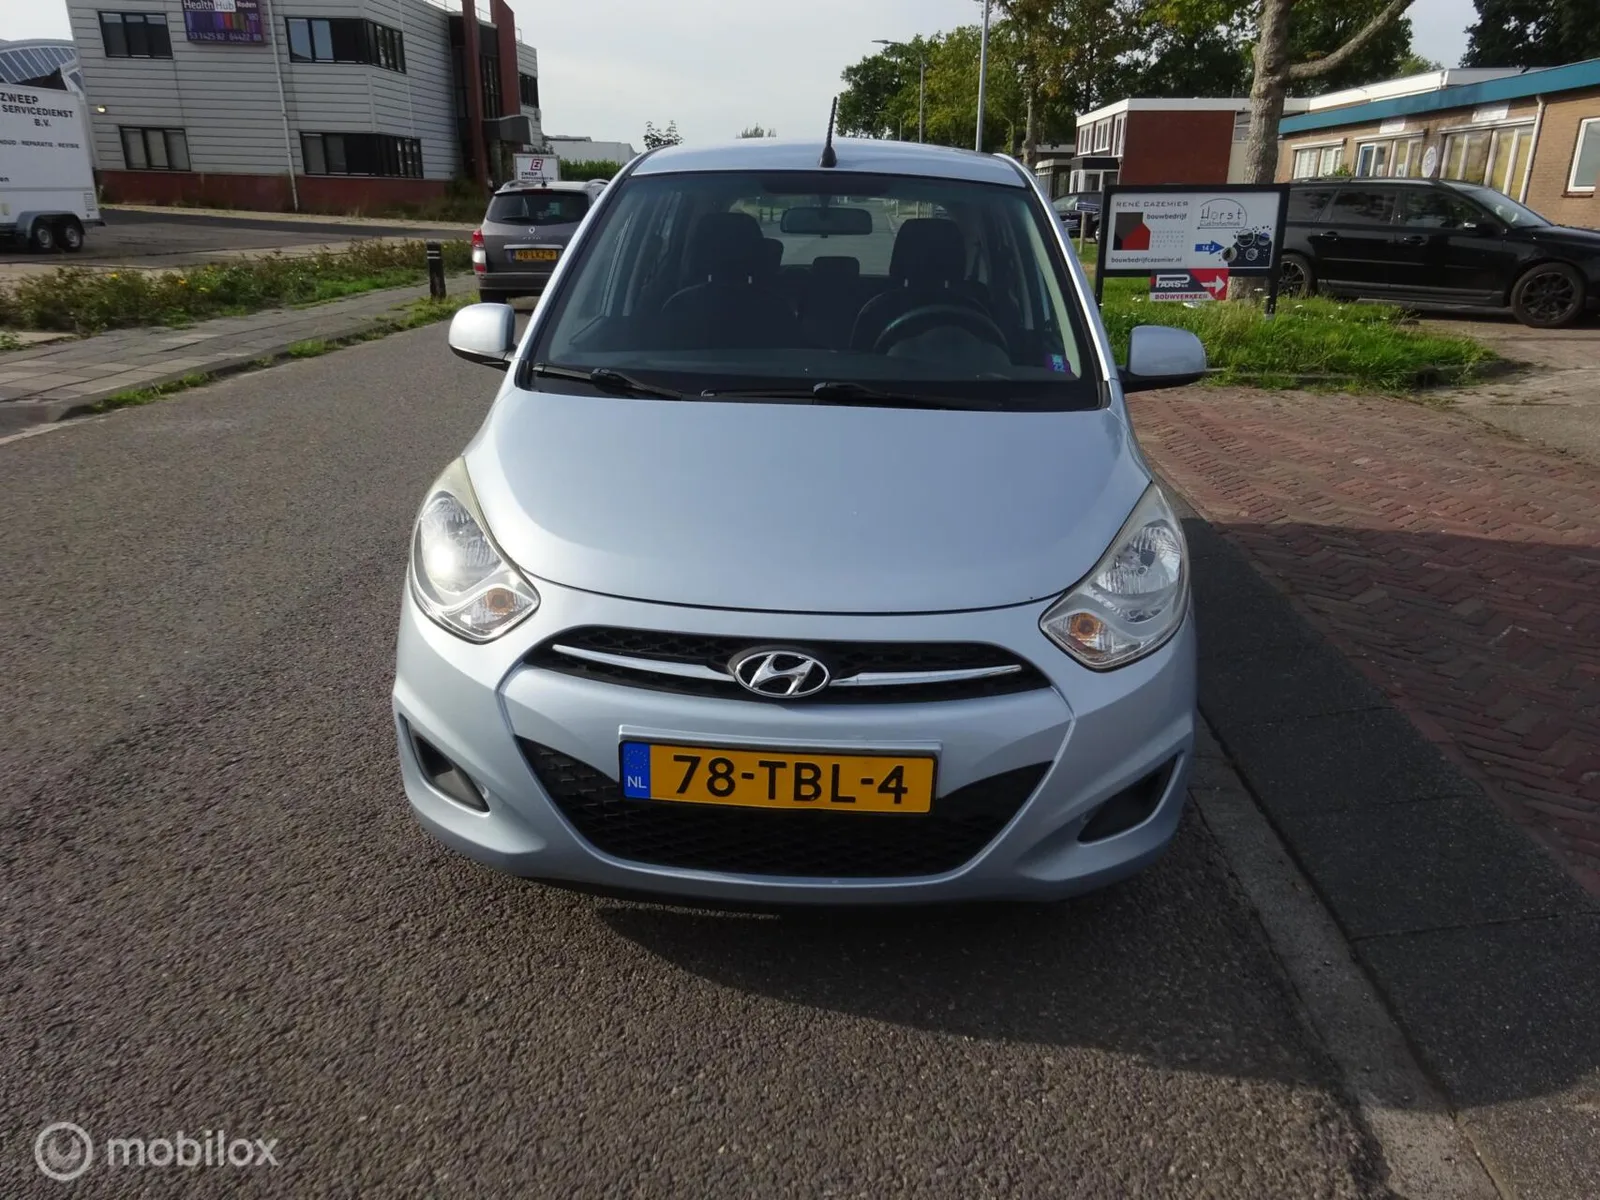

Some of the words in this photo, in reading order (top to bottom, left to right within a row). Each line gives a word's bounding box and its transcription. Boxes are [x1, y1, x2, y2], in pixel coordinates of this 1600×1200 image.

[0, 92, 39, 105] ZWEEP
[1, 104, 74, 118] SERVICEDIENST
[1143, 200, 1189, 208] CAZEMIER
[1146, 212, 1188, 221] bouwbedrijf
[1111, 256, 1182, 264] bouwbedrijfcazemier.nl
[627, 775, 647, 788] NL
[673, 754, 909, 805] 78-TBL-4
